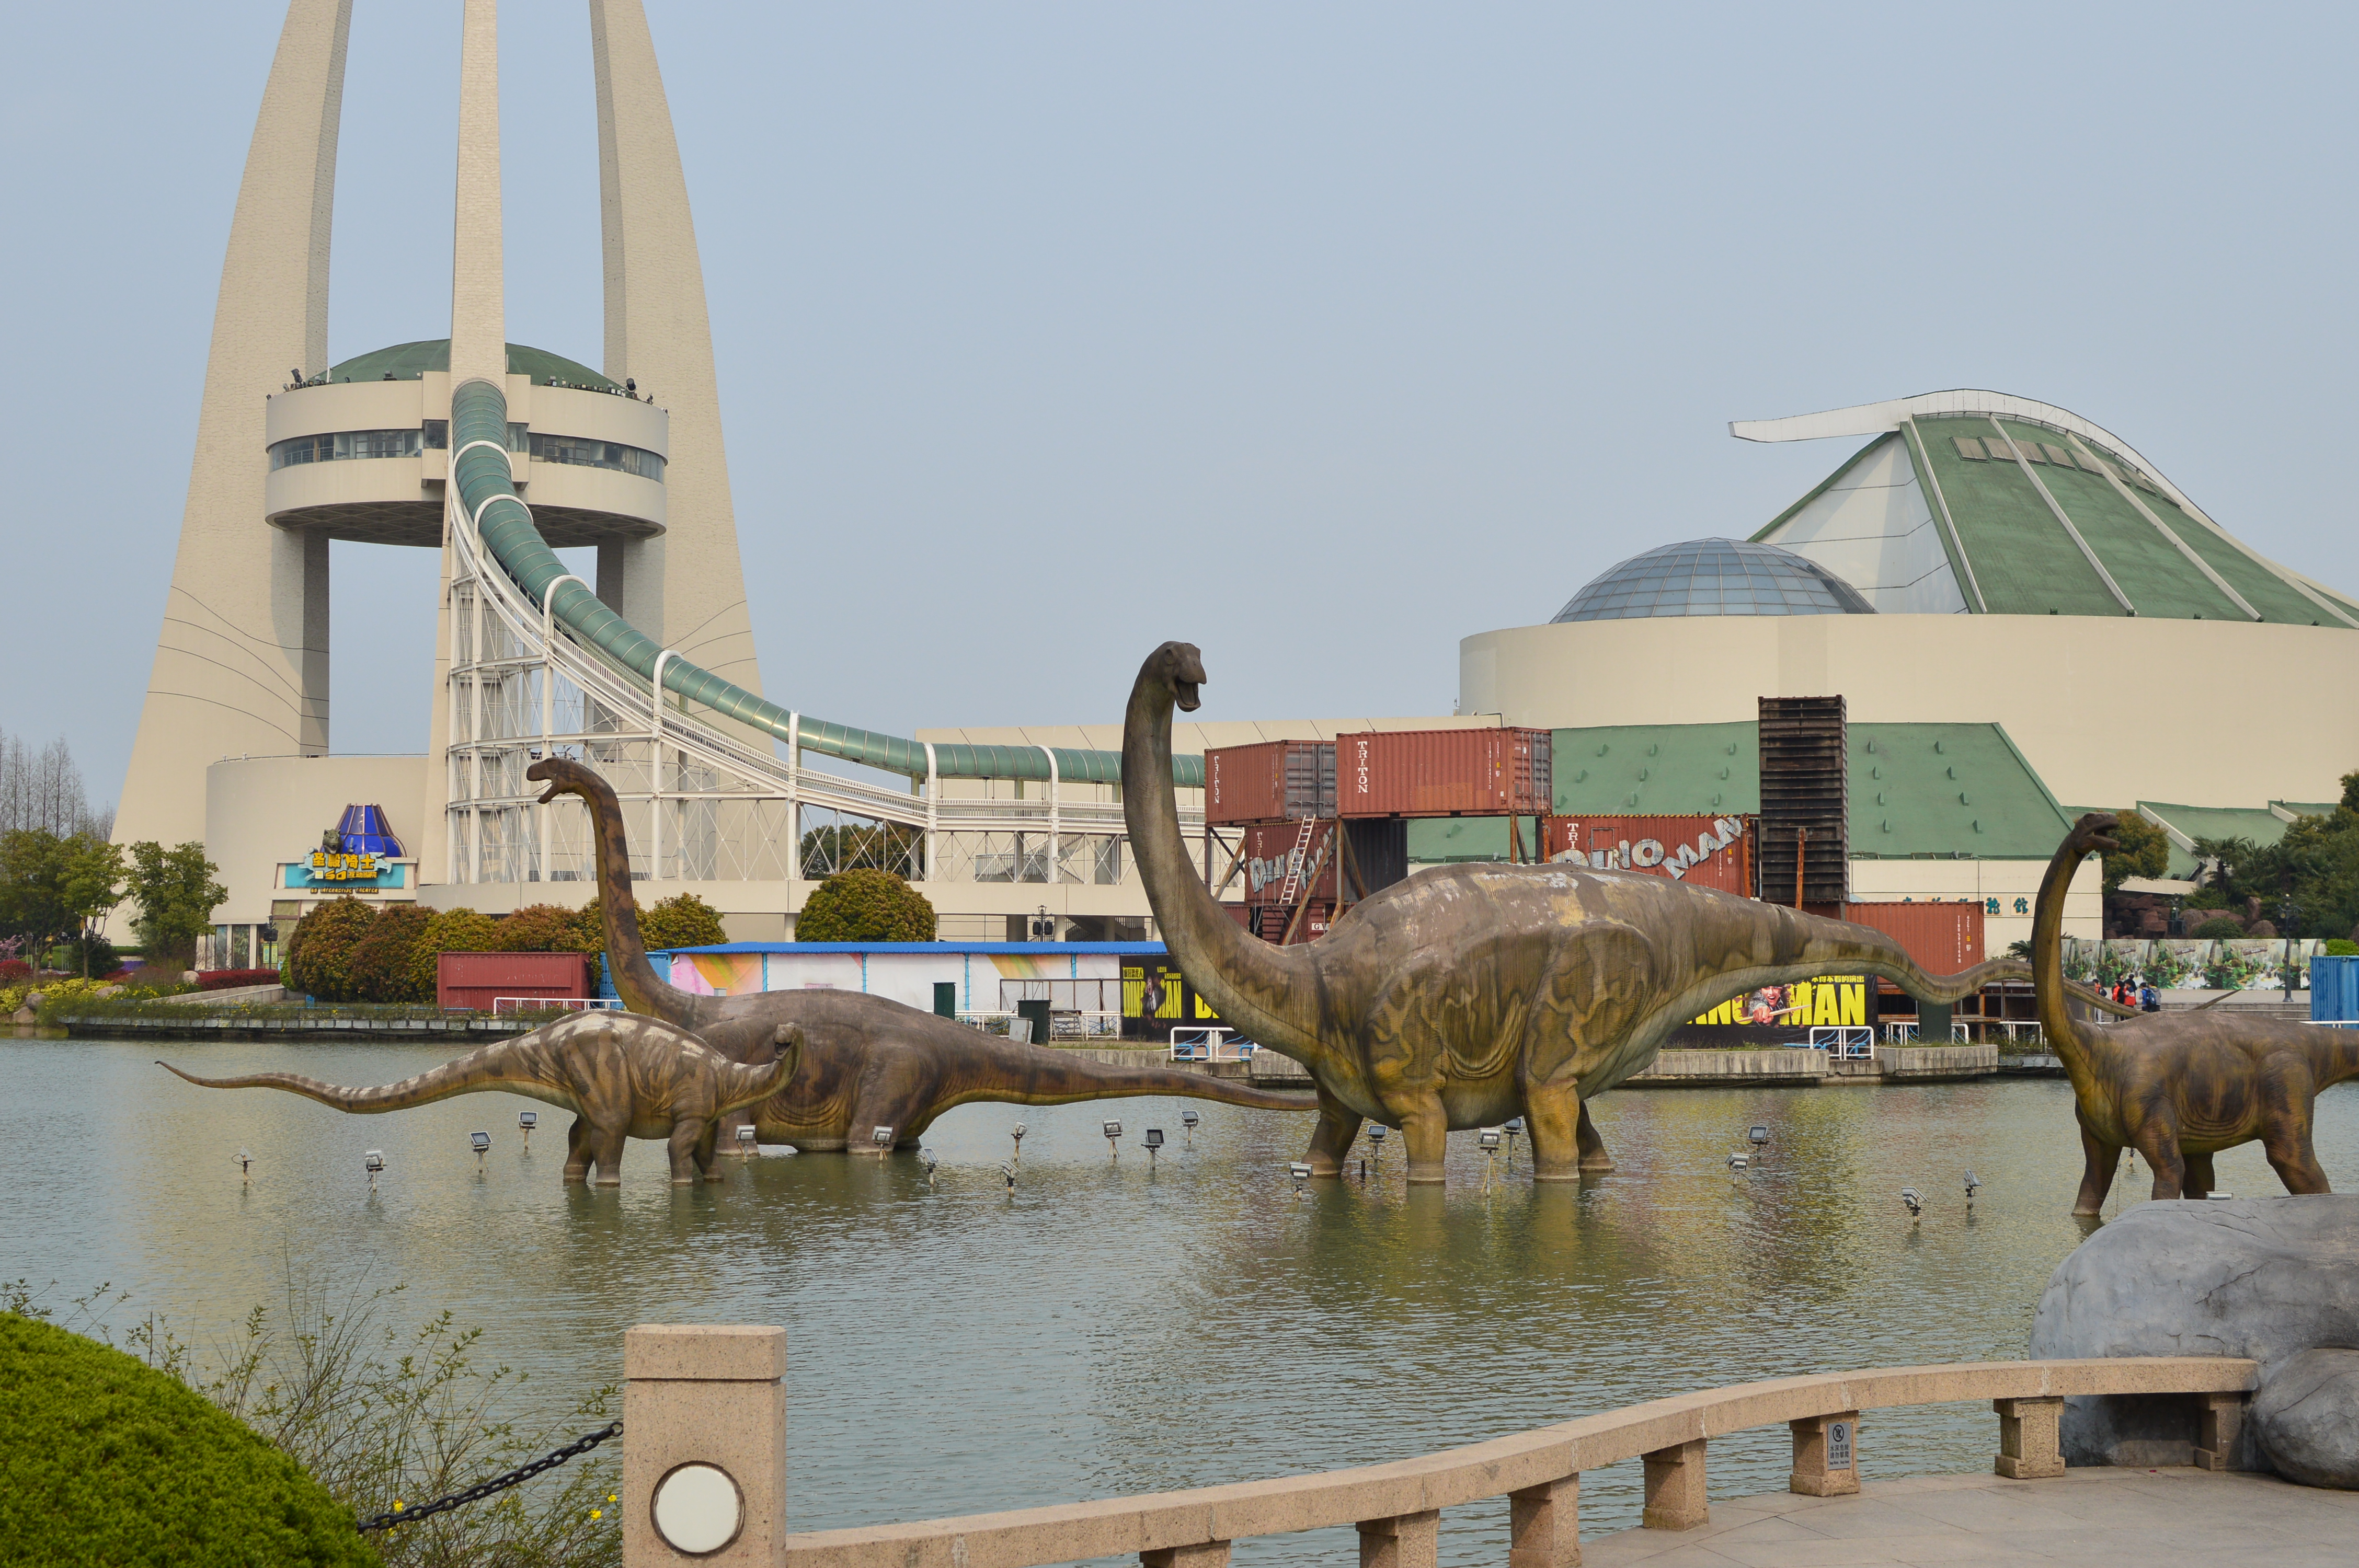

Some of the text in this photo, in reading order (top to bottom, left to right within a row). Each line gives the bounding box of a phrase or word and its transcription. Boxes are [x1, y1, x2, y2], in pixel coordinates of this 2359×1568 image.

[1358, 741, 1368, 793] TRITON
[312, 852, 375, 870] 圣殿骑士
[1662, 817, 1743, 880] MAN
[1780, 981, 1865, 1025] MAN
